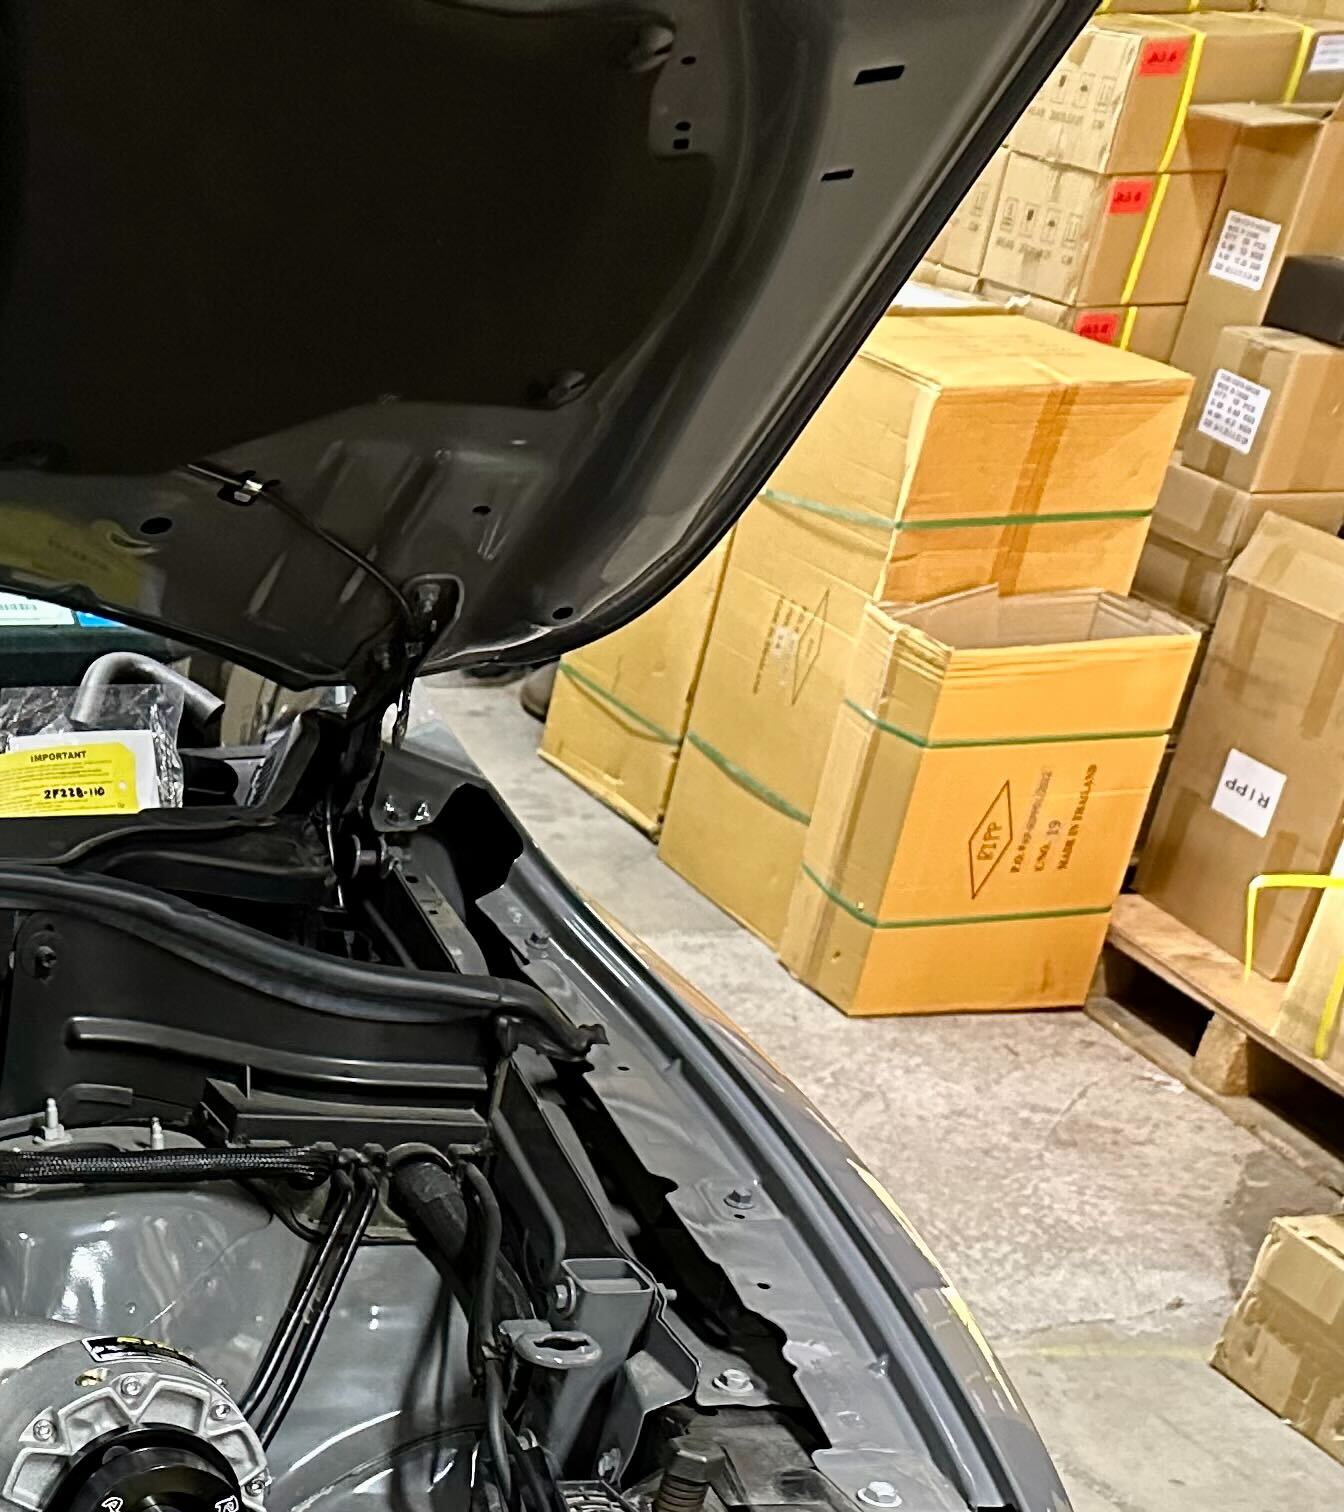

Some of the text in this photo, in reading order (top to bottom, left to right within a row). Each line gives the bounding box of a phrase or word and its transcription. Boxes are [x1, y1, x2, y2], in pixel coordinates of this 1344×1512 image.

[30, 750, 87, 763] IMPORTANT
[1225, 778, 1271, 809] RIPP
[976, 822, 1003, 861] RIPP
